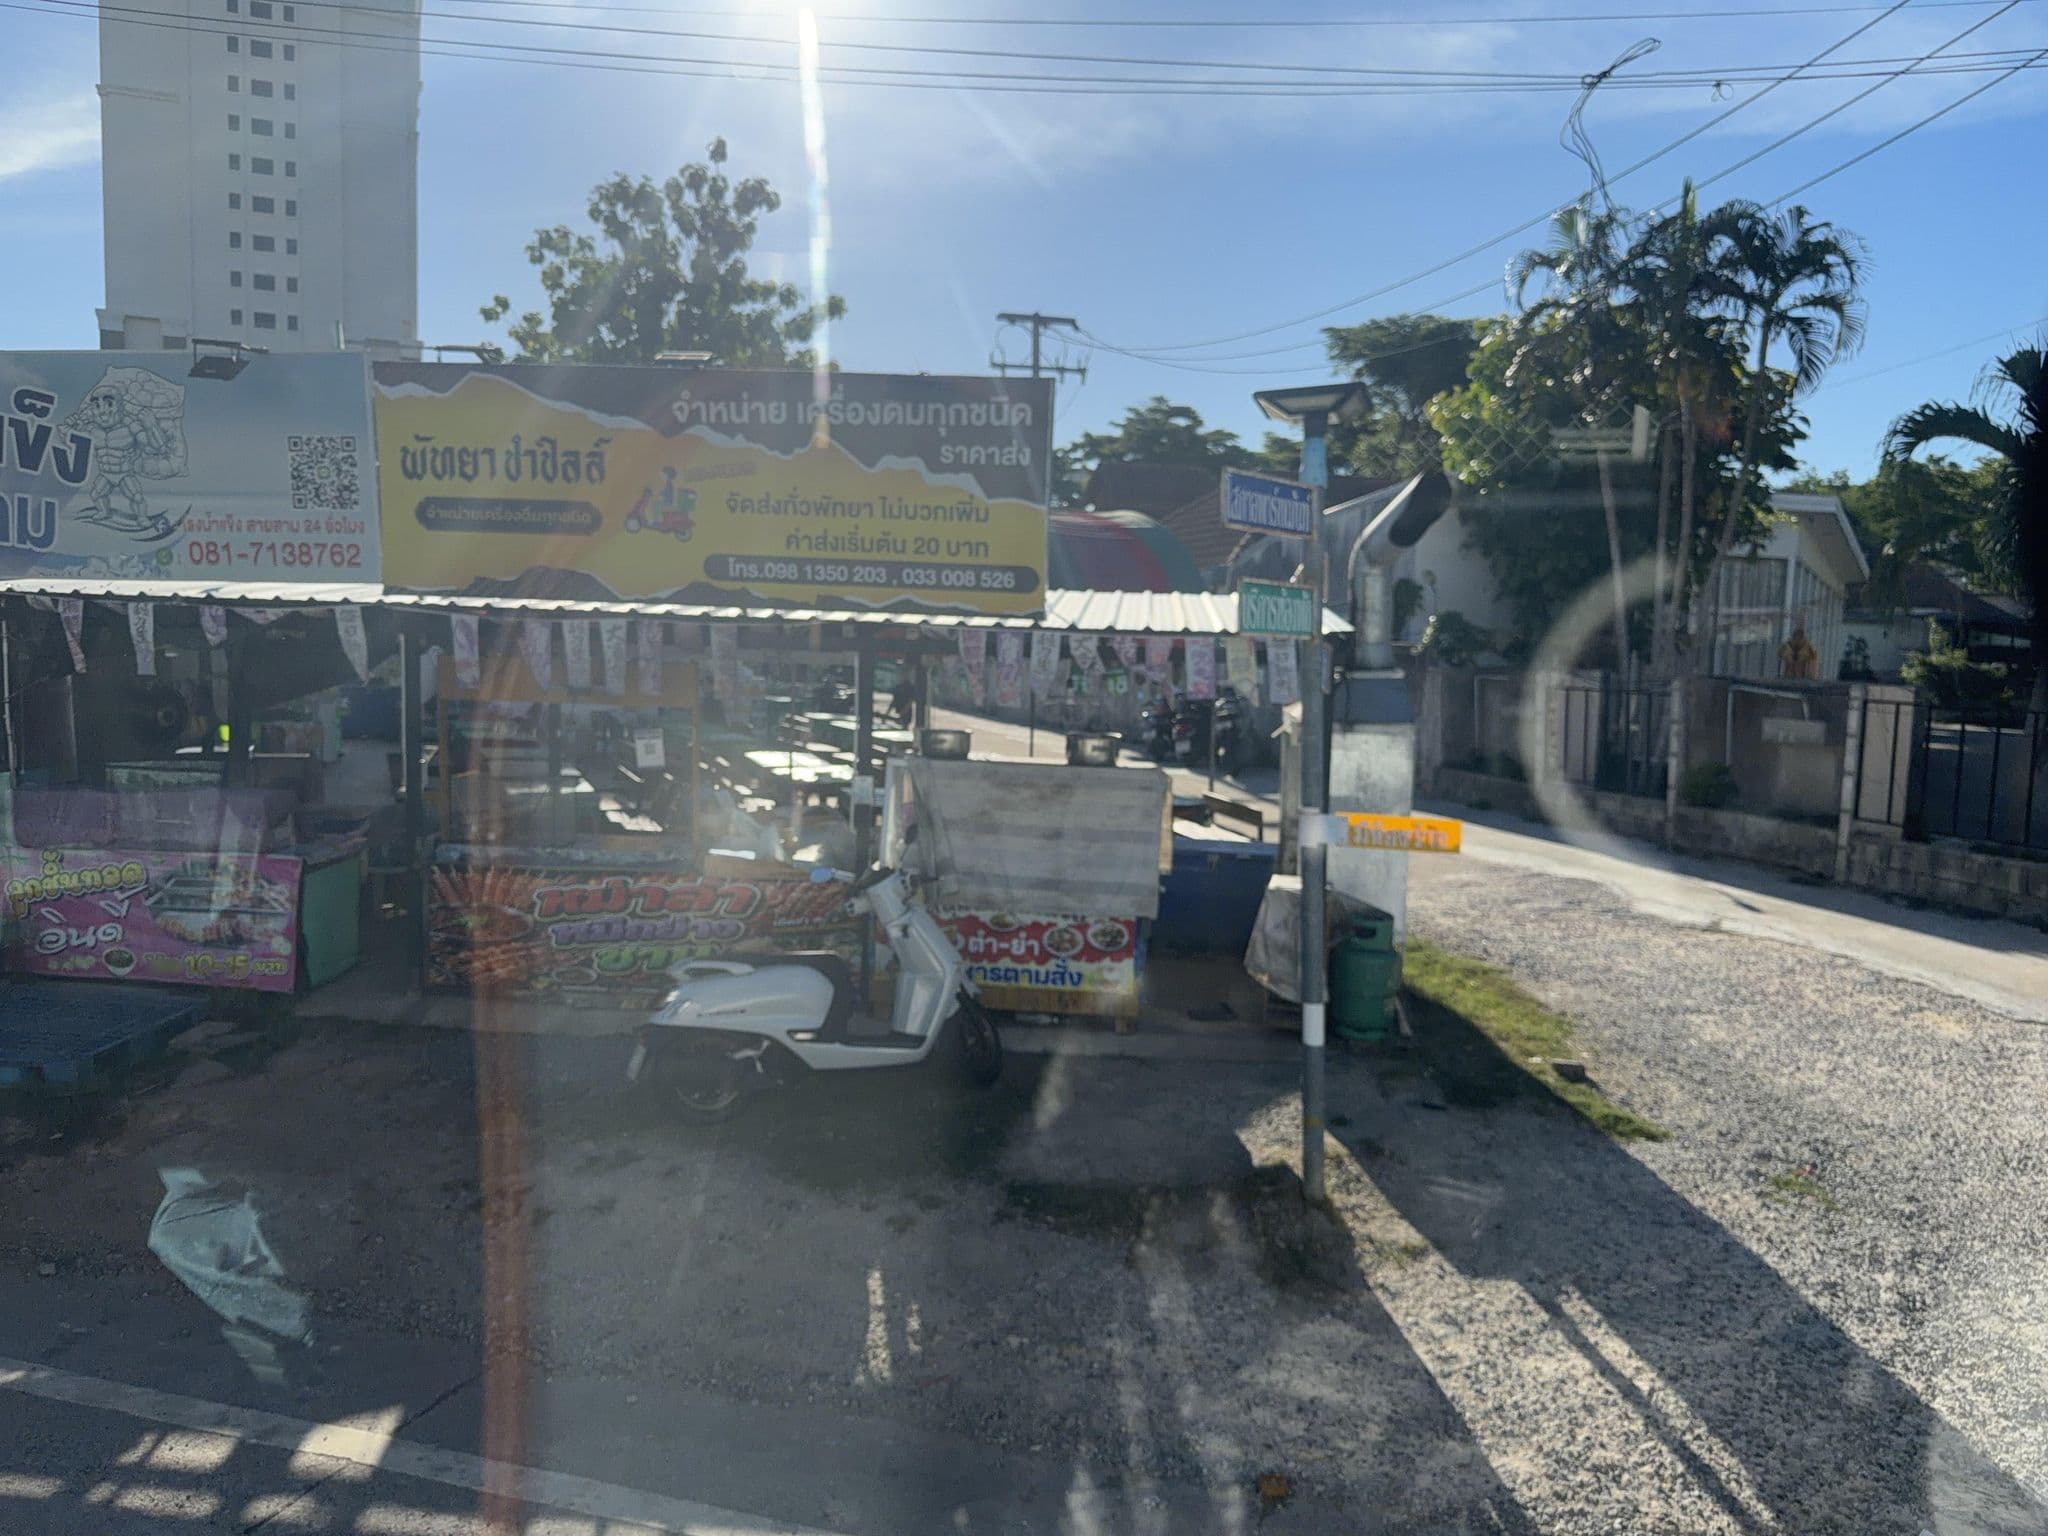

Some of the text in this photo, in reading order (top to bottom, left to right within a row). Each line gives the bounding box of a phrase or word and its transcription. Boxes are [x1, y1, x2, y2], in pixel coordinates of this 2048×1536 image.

[672, 390, 787, 424] จำหน่าย
[400, 434, 496, 481] พัทยา
[940, 441, 1031, 466] ราคาส่ง
[725, 486, 989, 523] จัดส่งทั่วพัทยา ไม่บวกเพิ่ม
[304, 519, 321, 533] 24
[188, 541, 361, 567] 081-7138762
[785, 525, 989, 557] ค่าส่งเริ่มต้น 20 บาท
[804, 564, 847, 582] 1350
[853, 565, 886, 583] 203
[902, 568, 936, 585] 033
[942, 570, 975, 587] 008
[980, 571, 1015, 588] 526
